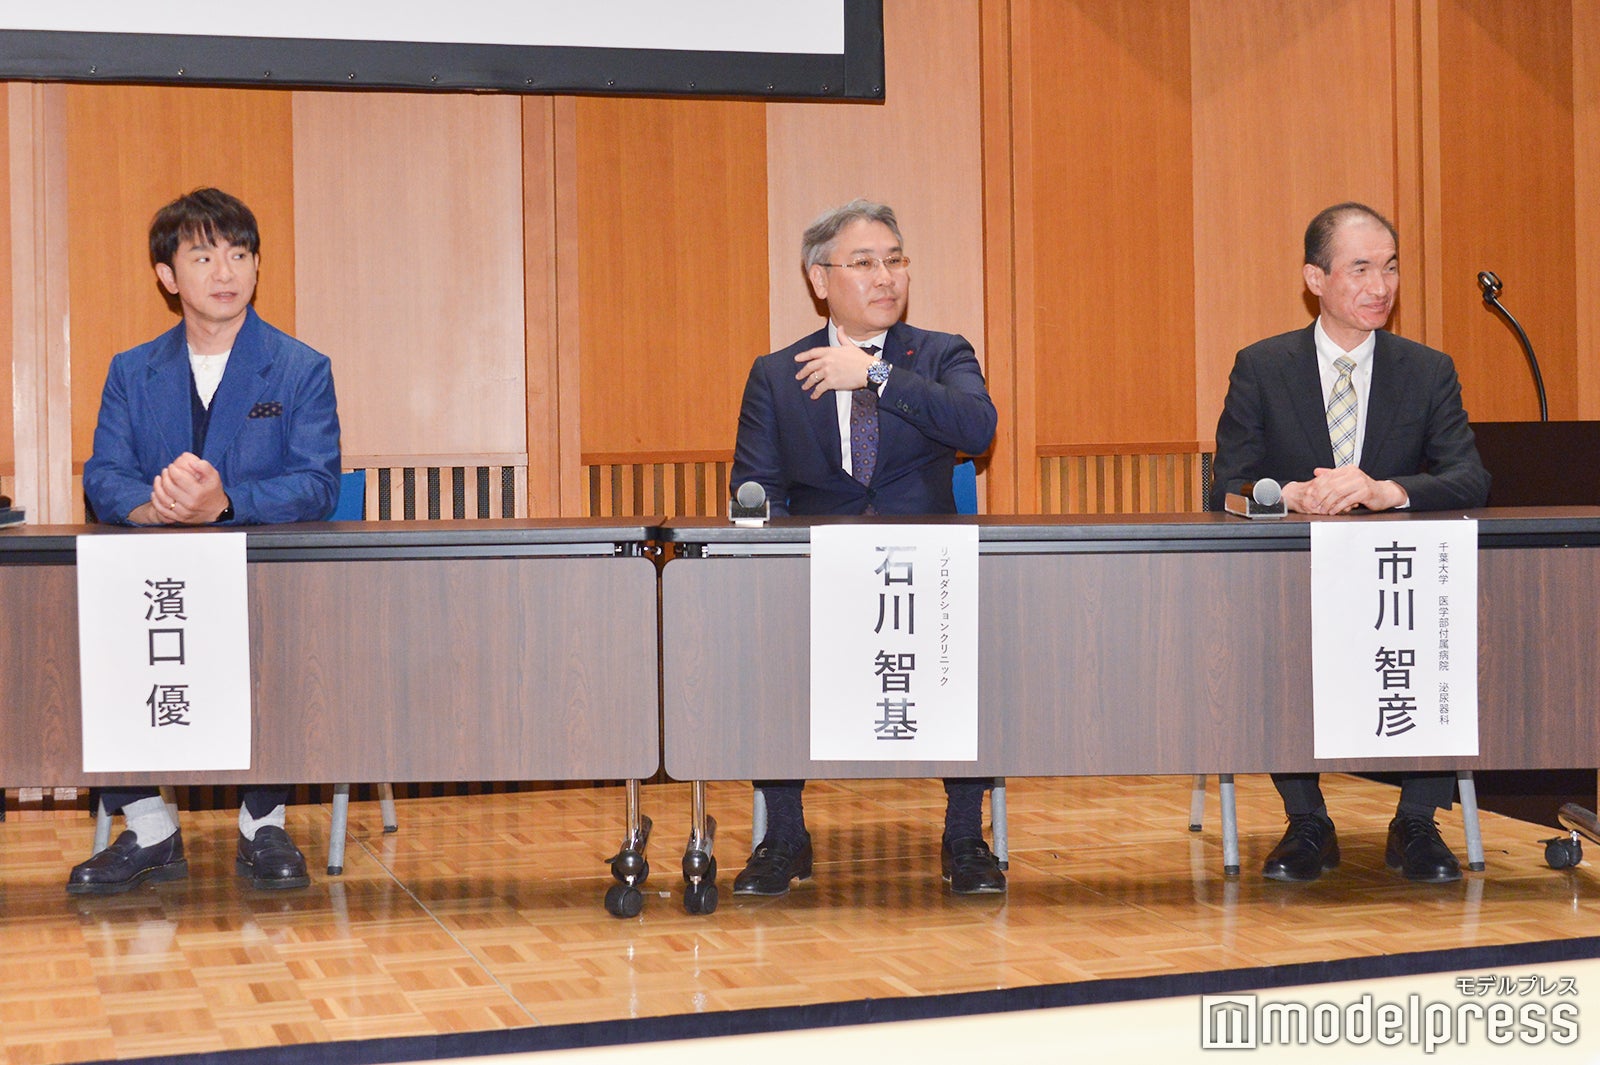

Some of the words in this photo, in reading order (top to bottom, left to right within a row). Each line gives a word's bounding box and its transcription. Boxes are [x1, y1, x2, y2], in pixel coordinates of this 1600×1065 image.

[874, 546, 917, 635] 石川
[1374, 540, 1417, 631] 市川
[1438, 541, 1449, 585] 千葉大学
[143, 577, 188, 666] 濱口
[939, 545, 950, 687] リプロダクションクリニック
[145, 683, 191, 727] 優
[873, 649, 918, 740] 智基
[1374, 646, 1417, 738] 智彦
[1438, 682, 1449, 725] 泌尿器科
